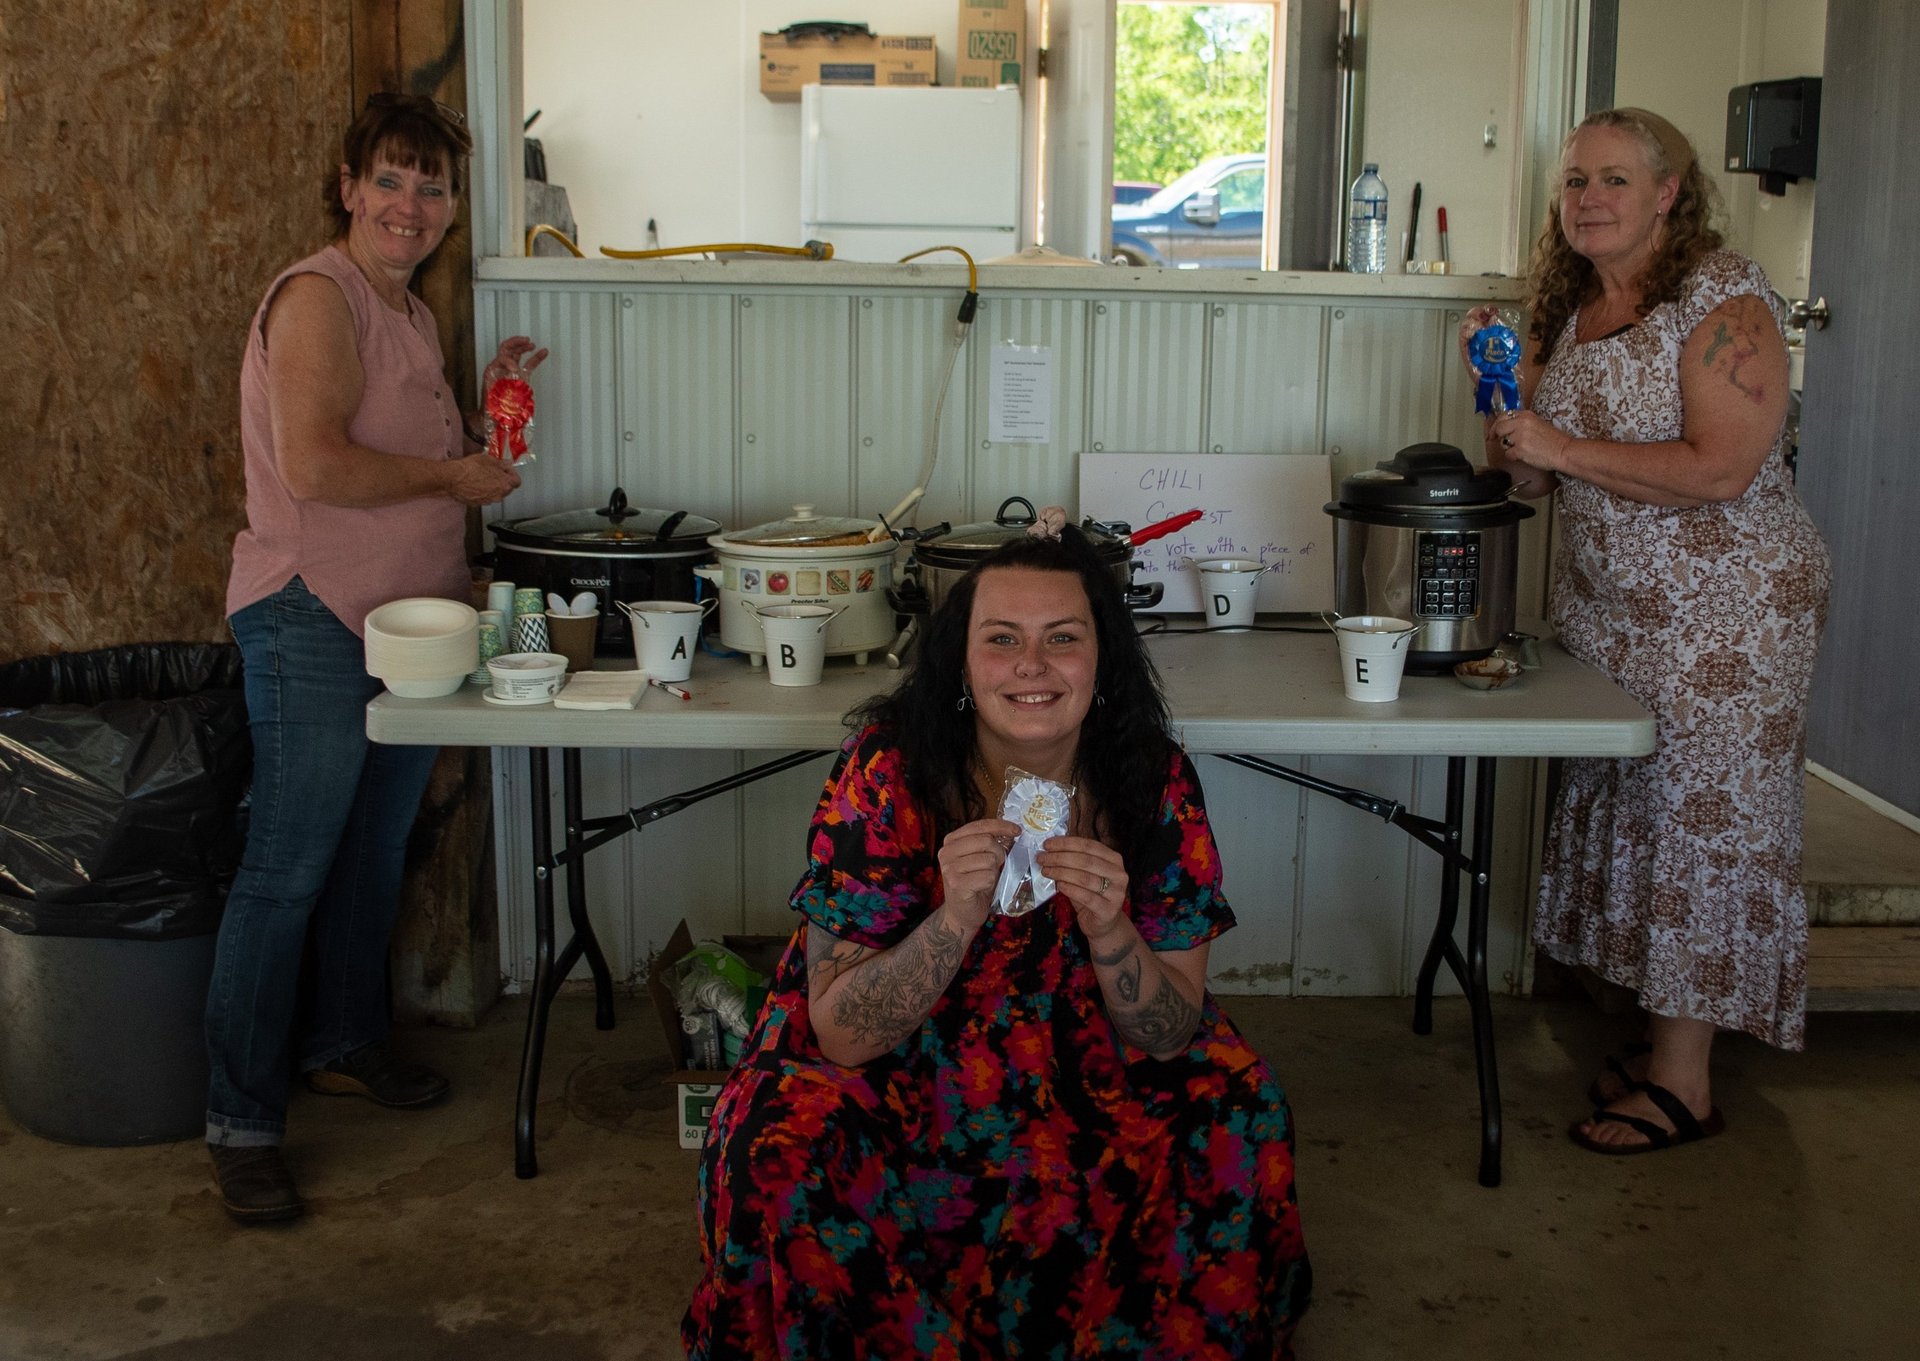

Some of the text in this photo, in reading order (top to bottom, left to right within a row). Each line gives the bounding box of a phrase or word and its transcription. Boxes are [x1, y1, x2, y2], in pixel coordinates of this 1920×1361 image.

[1139, 468, 1202, 491] CHILI
[1429, 488, 1459, 497] Starfrit
[1146, 500, 1233, 525] CEST
[1165, 536, 1197, 556] vote
[1206, 536, 1235, 555] with
[1240, 545, 1249, 553] a
[1260, 542, 1291, 563] piece
[1299, 541, 1316, 556] of
[1141, 560, 1159, 574] nto
[1213, 594, 1231, 616] D
[671, 636, 687, 660] A
[781, 643, 796, 669] B
[1356, 658, 1369, 683] E
[685, 1129, 698, 1139] 60
